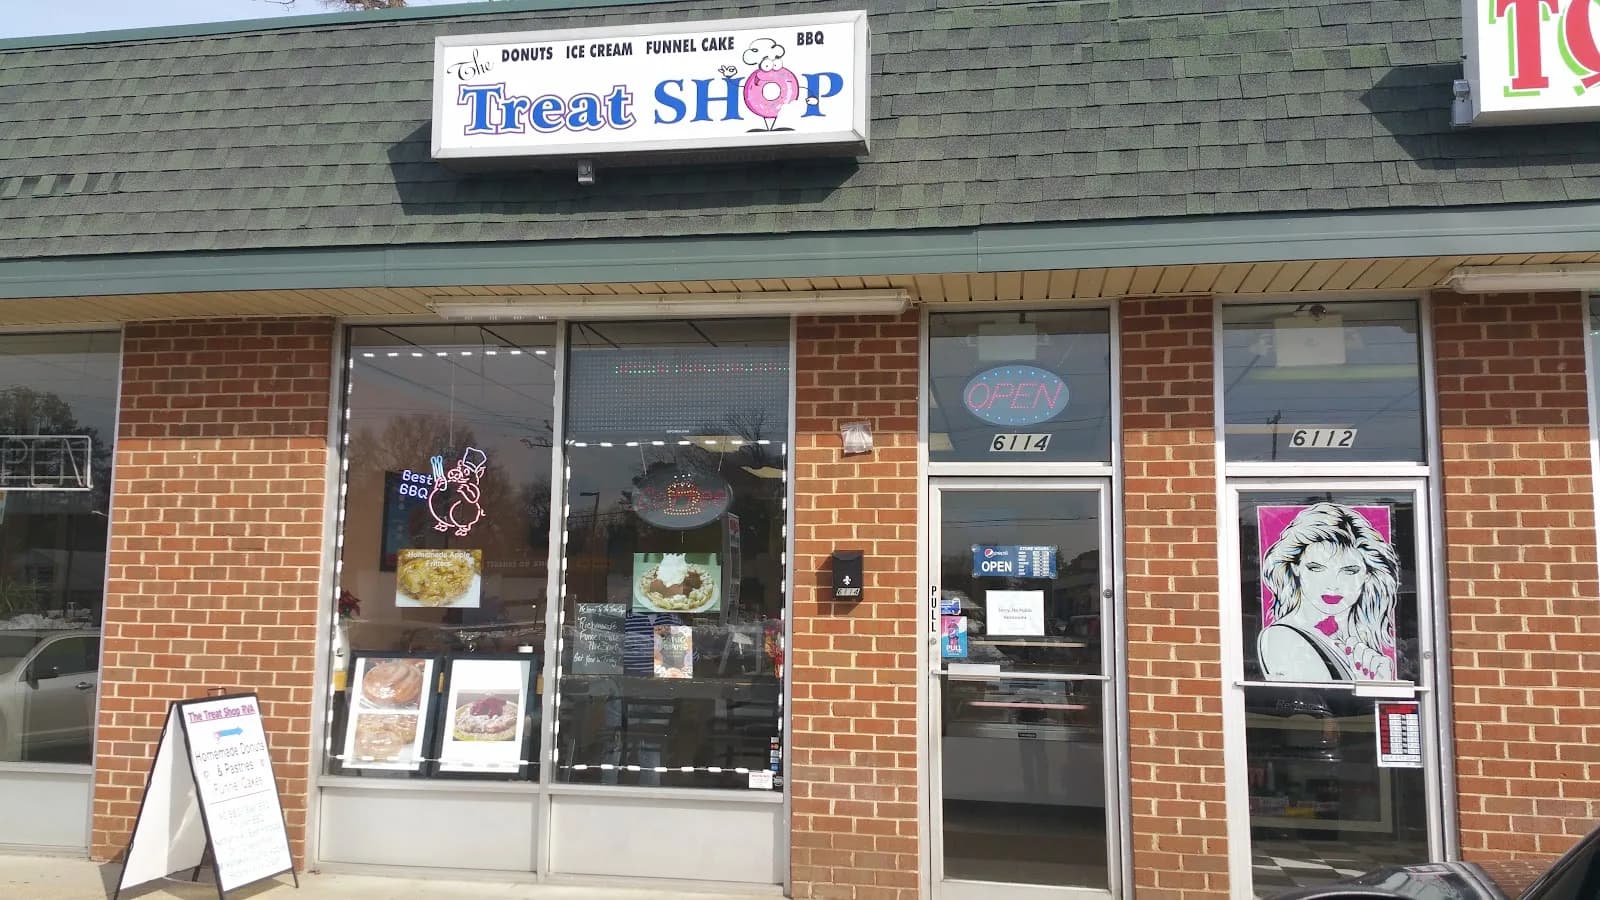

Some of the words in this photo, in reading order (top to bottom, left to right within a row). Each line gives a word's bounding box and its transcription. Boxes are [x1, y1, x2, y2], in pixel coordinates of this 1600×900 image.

[501, 46, 553, 62] DONUTS
[566, 45, 585, 59] ICE
[590, 42, 633, 57] CREAM
[646, 38, 697, 54] FUNNEL
[701, 36, 735, 51] CAKE
[797, 31, 825, 46] BBQ
[446, 48, 495, 81] The
[457, 82, 637, 135] Treat
[654, 67, 844, 125] SHOP
[967, 381, 1064, 410] OPEN
[993, 435, 1049, 450] 6114
[1293, 430, 1353, 447] 6112
[402, 469, 433, 485] Best
[400, 483, 428, 500] BBQ
[981, 560, 1013, 573] OPEN
[188, 711, 203, 722] The
[203, 709, 222, 721] Treat
[223, 706, 241, 717] Shop
[195, 747, 240, 764] Homemade
[240, 742, 265, 755] Donuts
